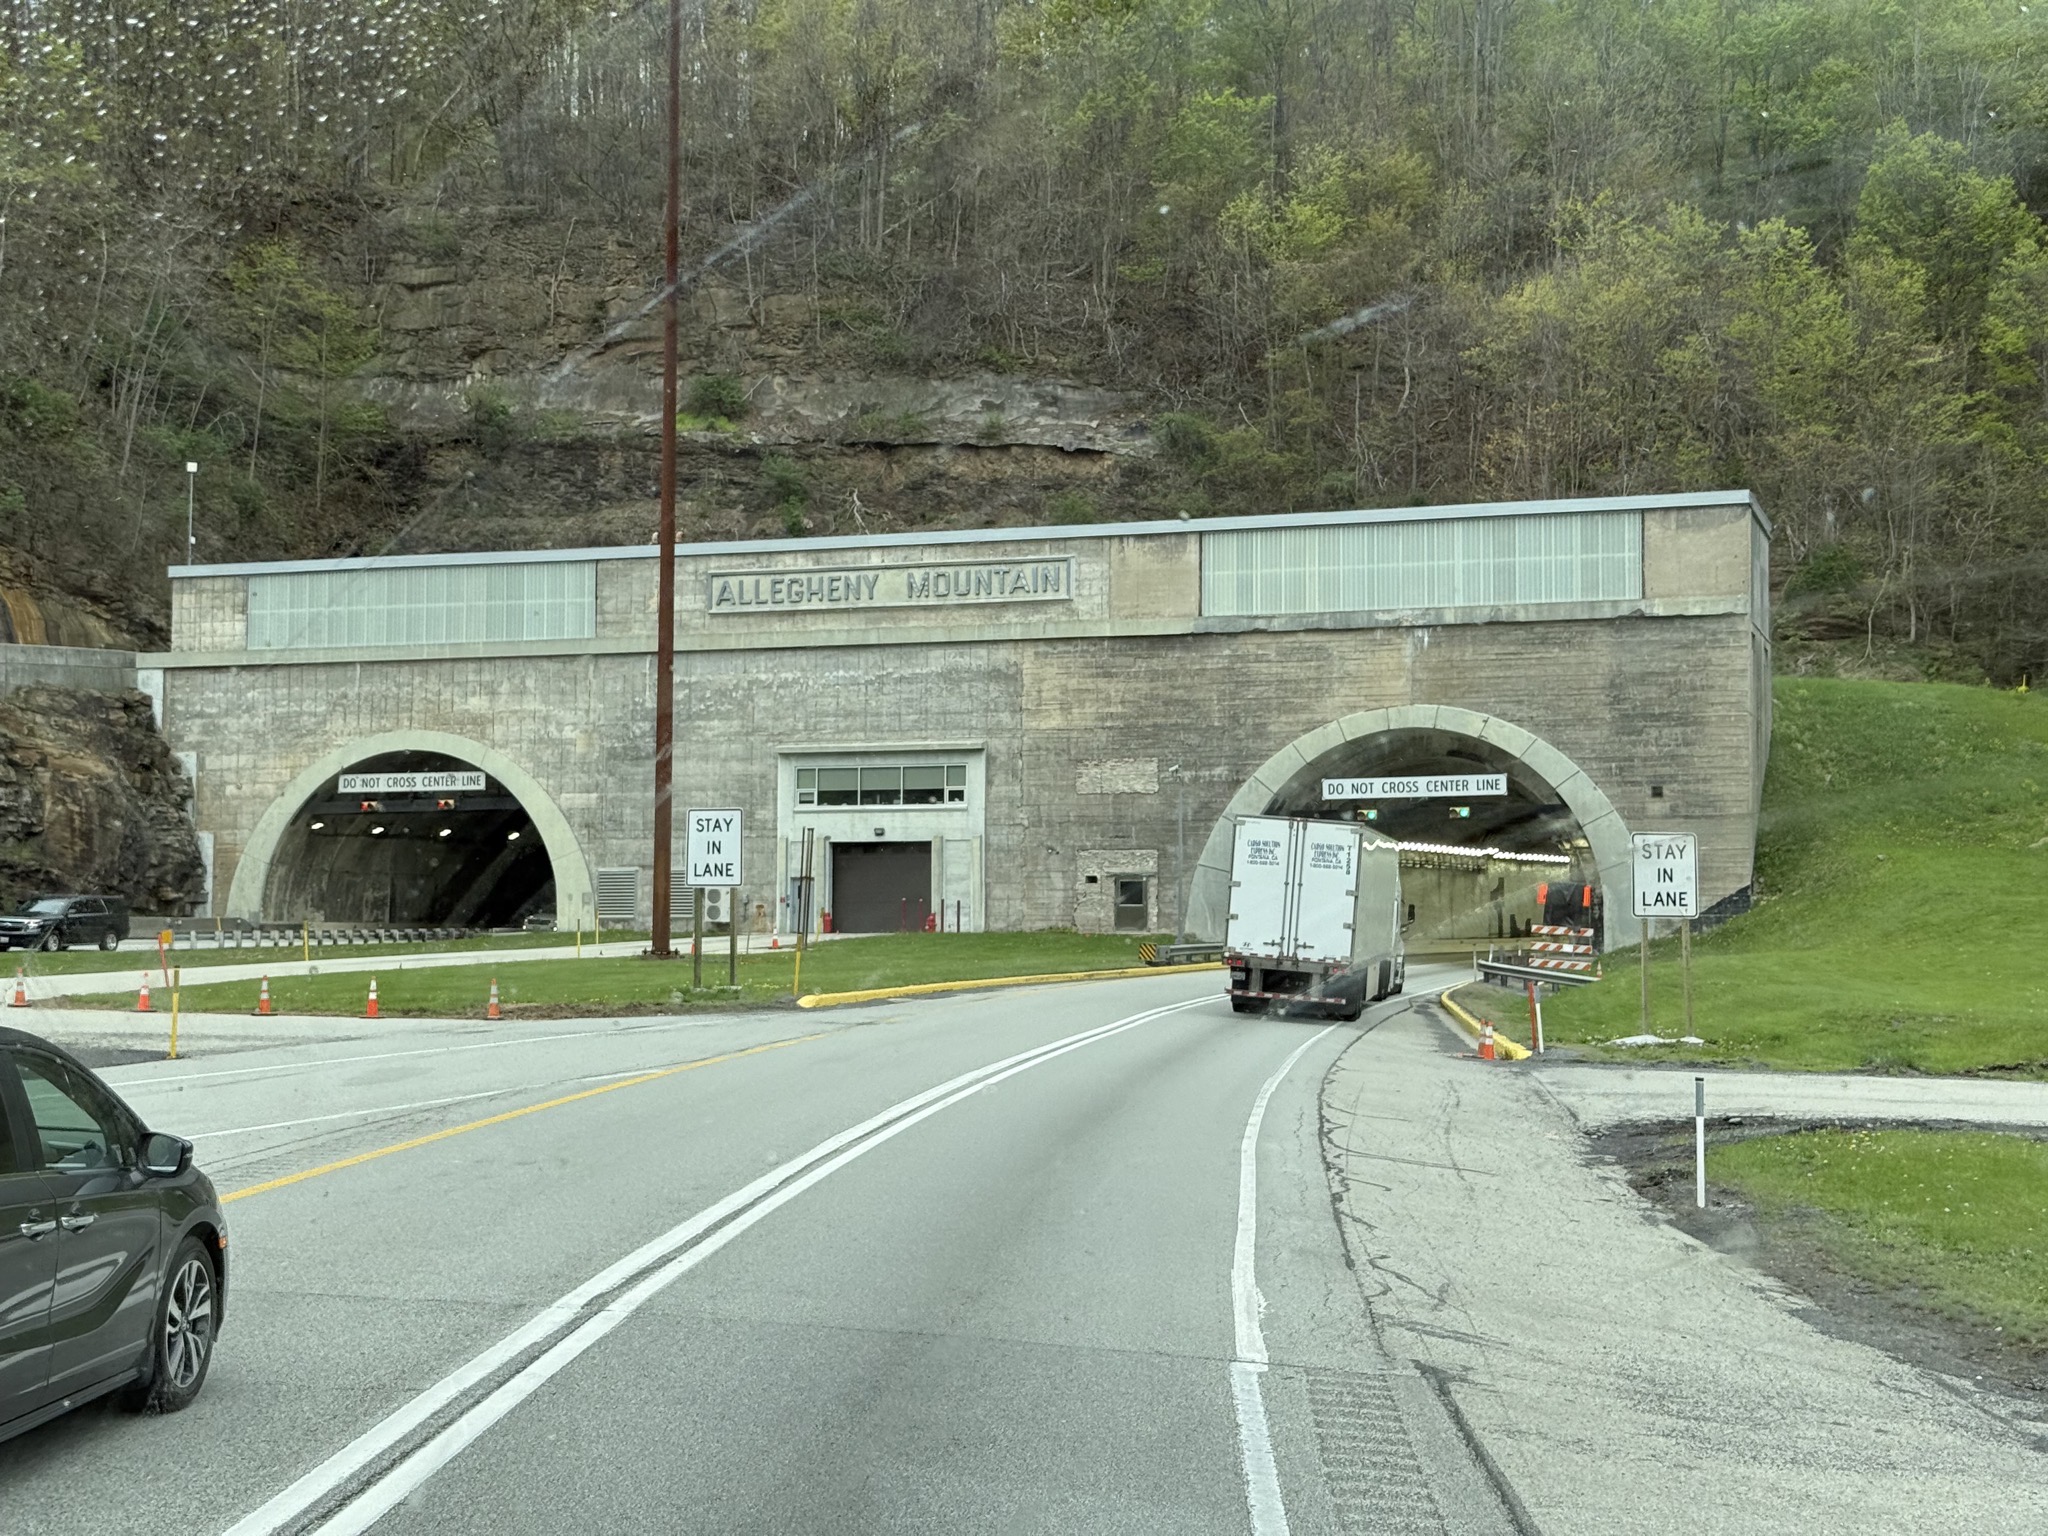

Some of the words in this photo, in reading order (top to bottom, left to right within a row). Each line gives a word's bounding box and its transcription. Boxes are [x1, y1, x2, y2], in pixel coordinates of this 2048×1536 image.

[716, 574, 880, 606] ALLEGHENY
[906, 565, 1060, 598] MOUNTAIN
[342, 777, 357, 788] DO
[361, 777, 380, 788] NOT
[386, 776, 417, 788] CROSS
[421, 775, 457, 787] CENTER
[461, 774, 481, 786] LINE
[1328, 783, 1344, 795] DO
[1351, 782, 1374, 794] NOT
[1381, 781, 1419, 794] CROSS
[1426, 779, 1469, 792] CENTER
[1476, 778, 1501, 791] LINE
[695, 817, 734, 833] STAY
[707, 840, 721, 854] IN
[1641, 843, 1687, 859] STAY
[694, 863, 734, 877] LANE
[1657, 868, 1673, 883] IN
[1642, 891, 1688, 907] LANE
